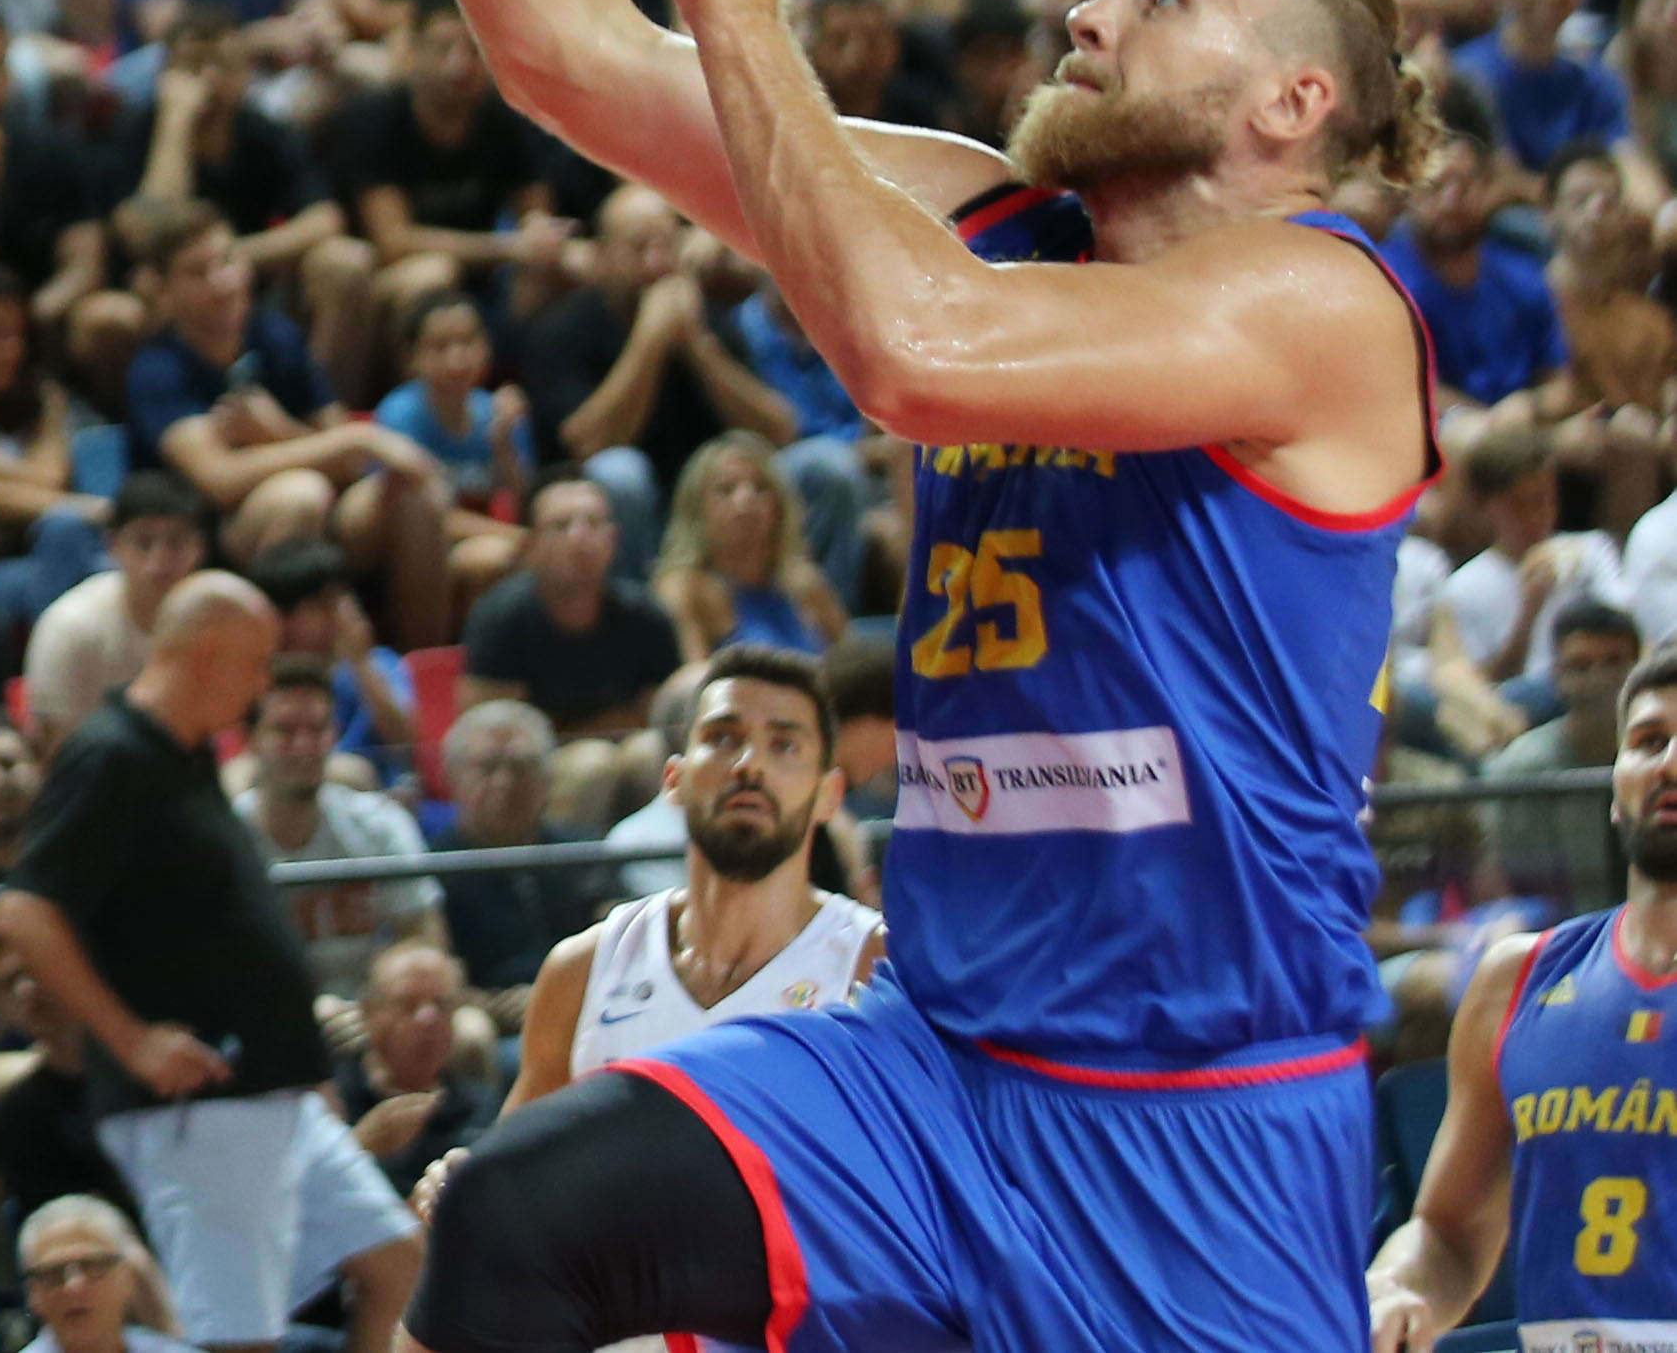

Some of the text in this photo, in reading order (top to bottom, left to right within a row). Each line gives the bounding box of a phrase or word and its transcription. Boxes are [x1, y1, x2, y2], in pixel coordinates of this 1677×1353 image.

[911, 528, 1048, 680] 25
[993, 761, 1160, 791] TRANSILVANIA
[1574, 1176, 1647, 1276] 8
